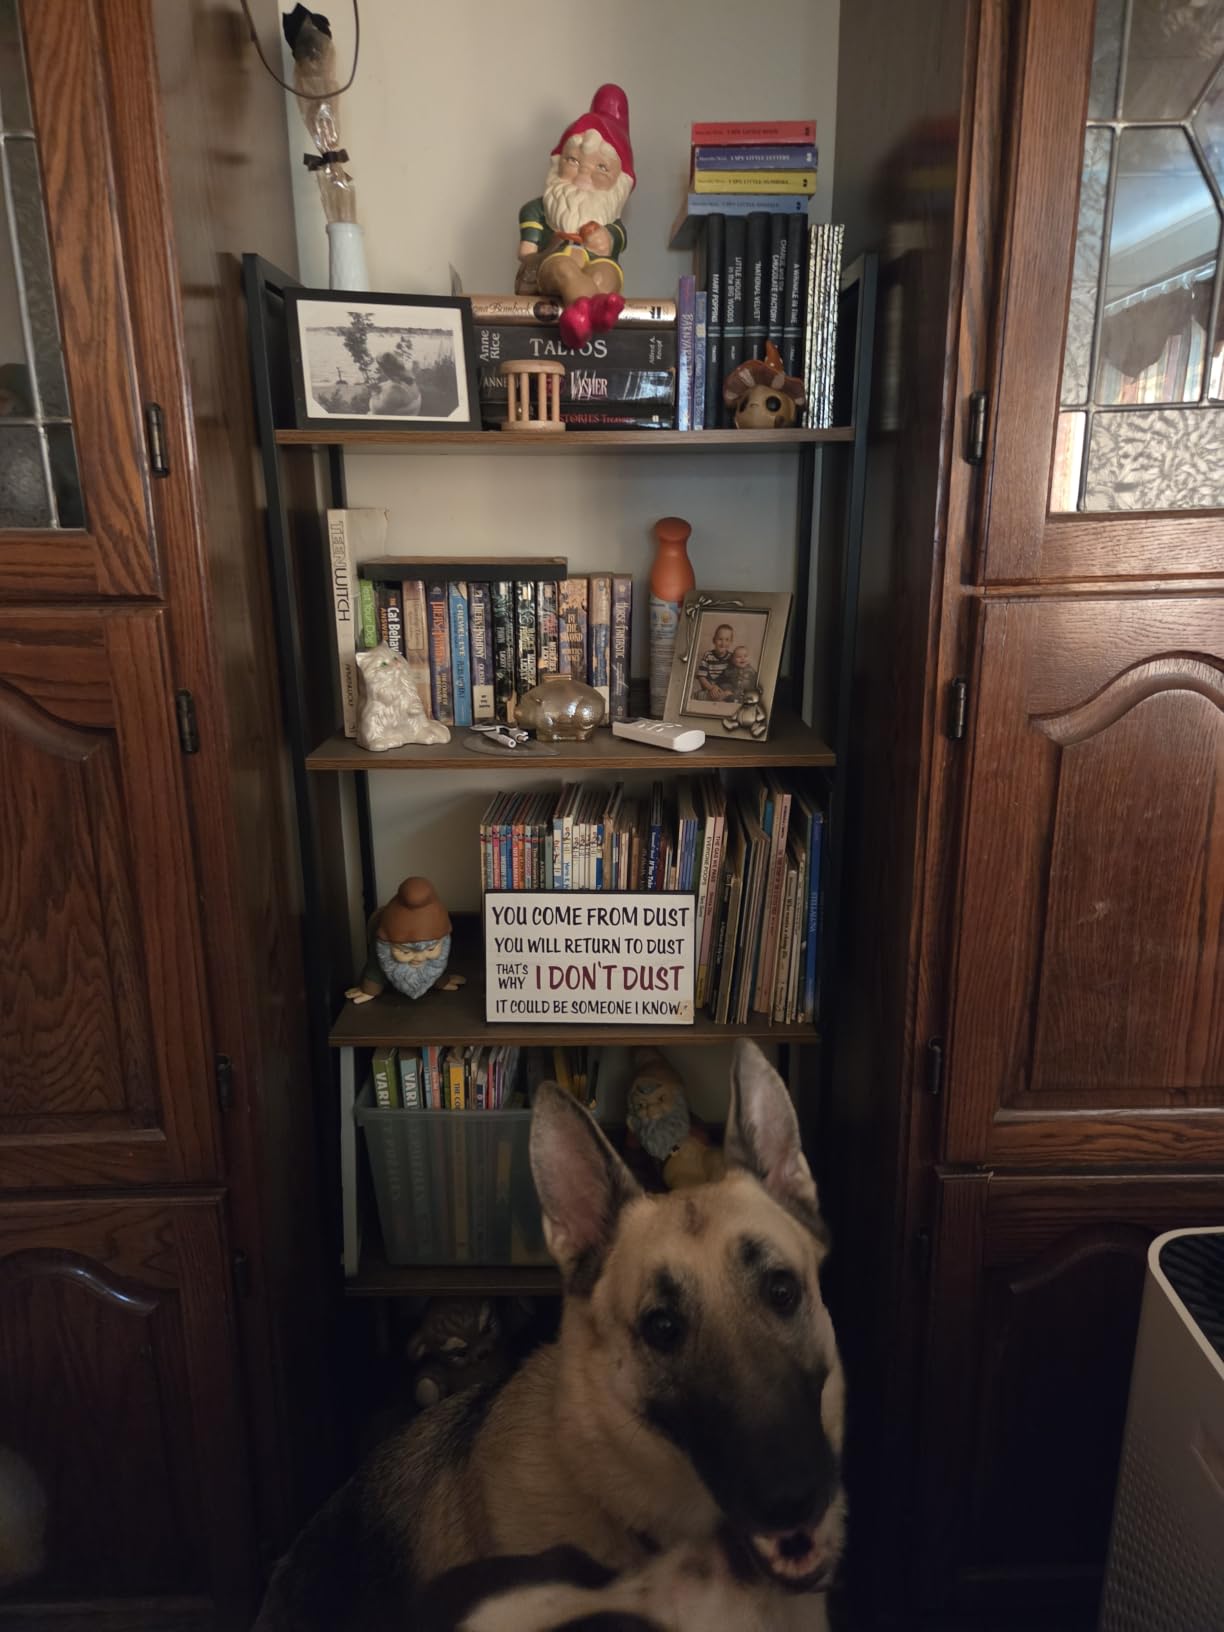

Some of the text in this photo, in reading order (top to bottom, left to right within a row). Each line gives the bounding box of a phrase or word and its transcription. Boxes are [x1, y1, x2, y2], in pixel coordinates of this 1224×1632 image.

[727, 285, 735, 298] BIG
[734, 278, 742, 302] HOUSE
[769, 254, 780, 323] CHOCOLATE FACTORY
[791, 268, 800, 299] WRINKLE
[711, 274, 719, 323] MARY POPPINS
[726, 298, 735, 323] WOODS
[790, 308, 798, 324] TIME
[479, 328, 490, 362] Anne
[490, 331, 501, 360] Rice
[529, 337, 608, 359] TALOS
[615, 602, 630, 625] HORSE
[387, 607, 403, 655] Cat Behav
[615, 625, 629, 659] FANTASTIC
[703, 836, 713, 865] EVERYONE
[711, 835, 722, 884] THE GAS WE PASS
[491, 906, 690, 927] YOU COME FROM DUST
[494, 937, 685, 955] YOU WILL RETURN TO DUST
[496, 963, 529, 976] THAT'S
[535, 965, 542, 990] I
[548, 961, 618, 991] DON'T
[622, 965, 685, 991] DUST
[498, 976, 526, 990] WHY
[496, 1000, 508, 1014] IT
[510, 1000, 550, 1014] COULD
[553, 1000, 568, 1014] BE
[572, 1000, 632, 1015] SOMEONE
[635, 1001, 640, 1014] I
